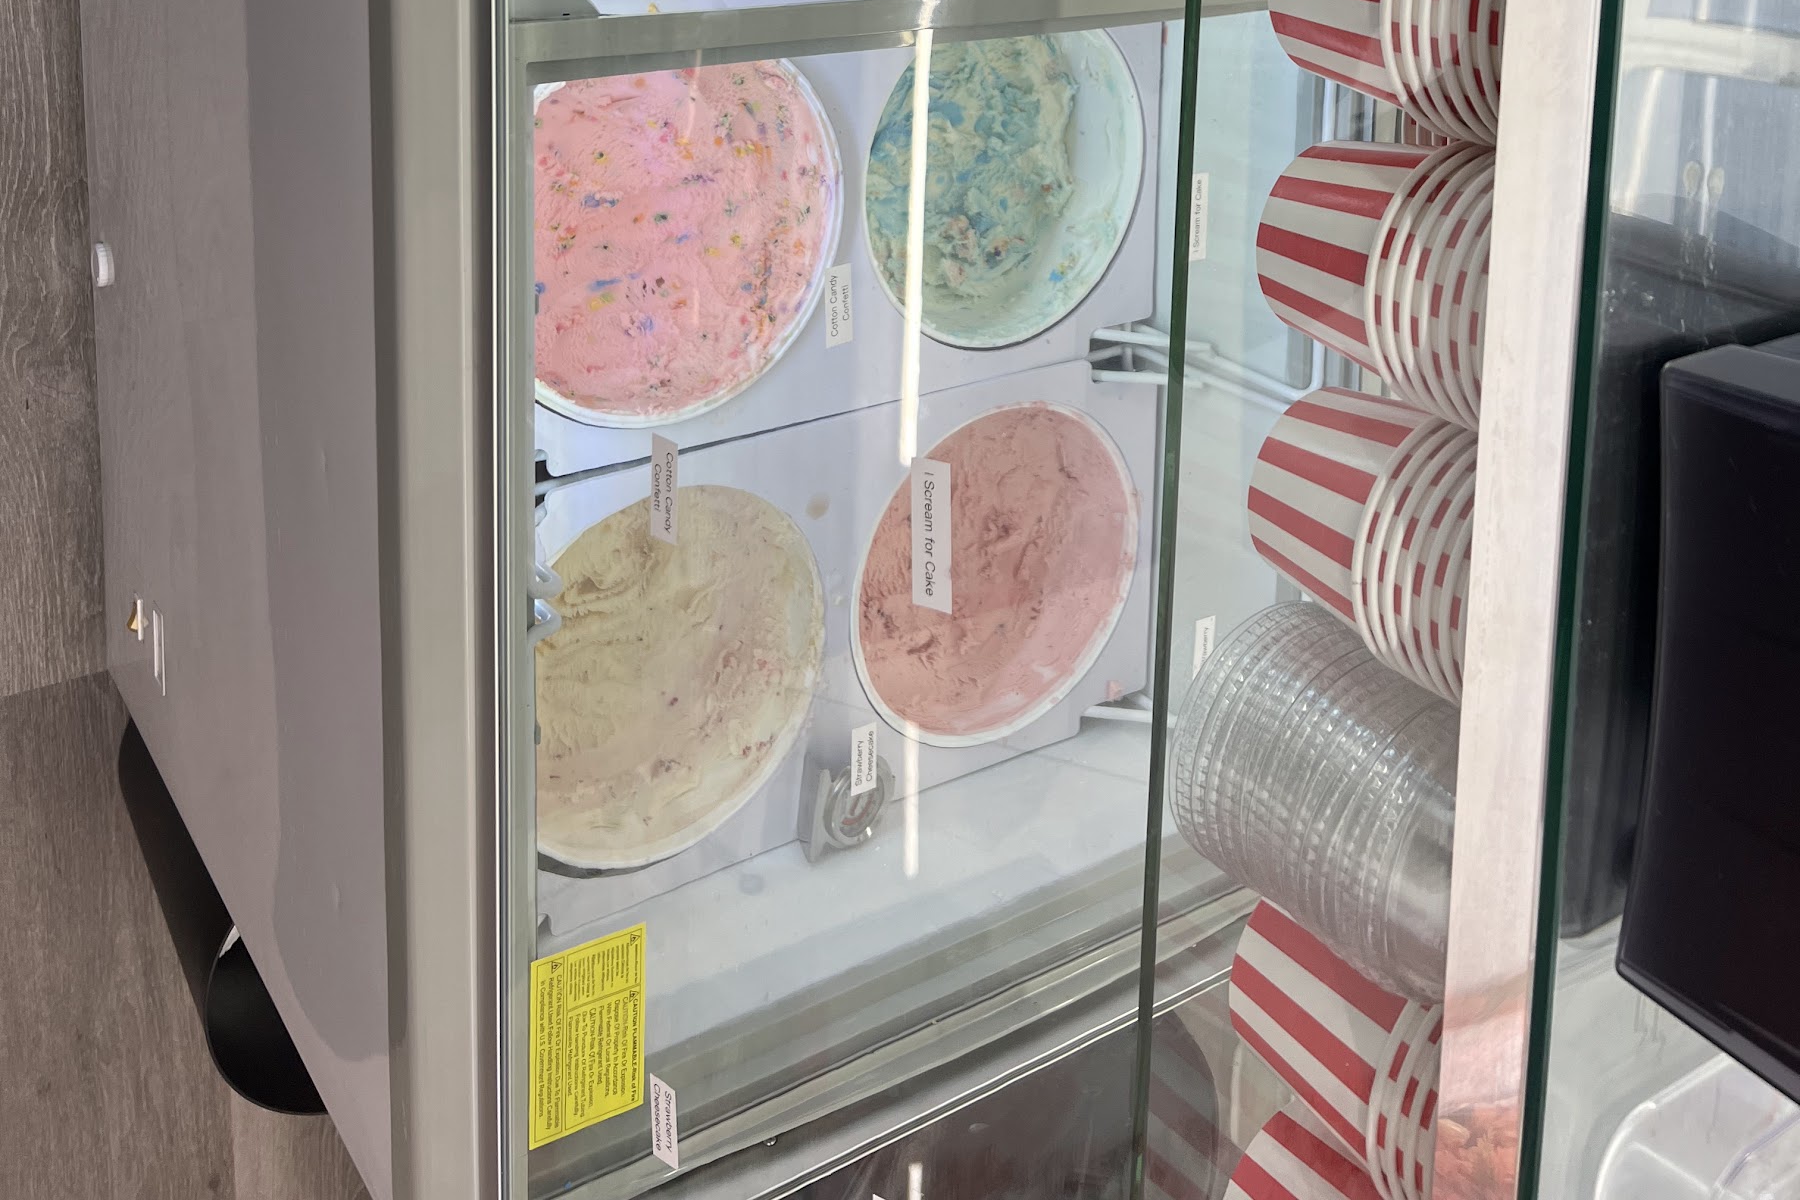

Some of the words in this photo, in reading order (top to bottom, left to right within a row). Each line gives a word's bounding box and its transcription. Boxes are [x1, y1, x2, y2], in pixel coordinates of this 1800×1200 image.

[1194, 179, 1202, 201] Cake
[829, 275, 838, 304] Candy
[841, 284, 849, 321] Confetti
[830, 306, 839, 337] Cotton
[654, 463, 662, 512] Confetti
[666, 452, 674, 492] Cotton
[664, 496, 673, 533] Candy
[924, 480, 935, 531] Scream
[925, 537, 935, 557] for
[925, 561, 935, 596] Cake
[855, 740, 864, 787] Strawberry
[866, 731, 874, 782] Cheesecake
[653, 1083, 662, 1151] Cheesecake
[664, 1091, 673, 1153] Strawberry
